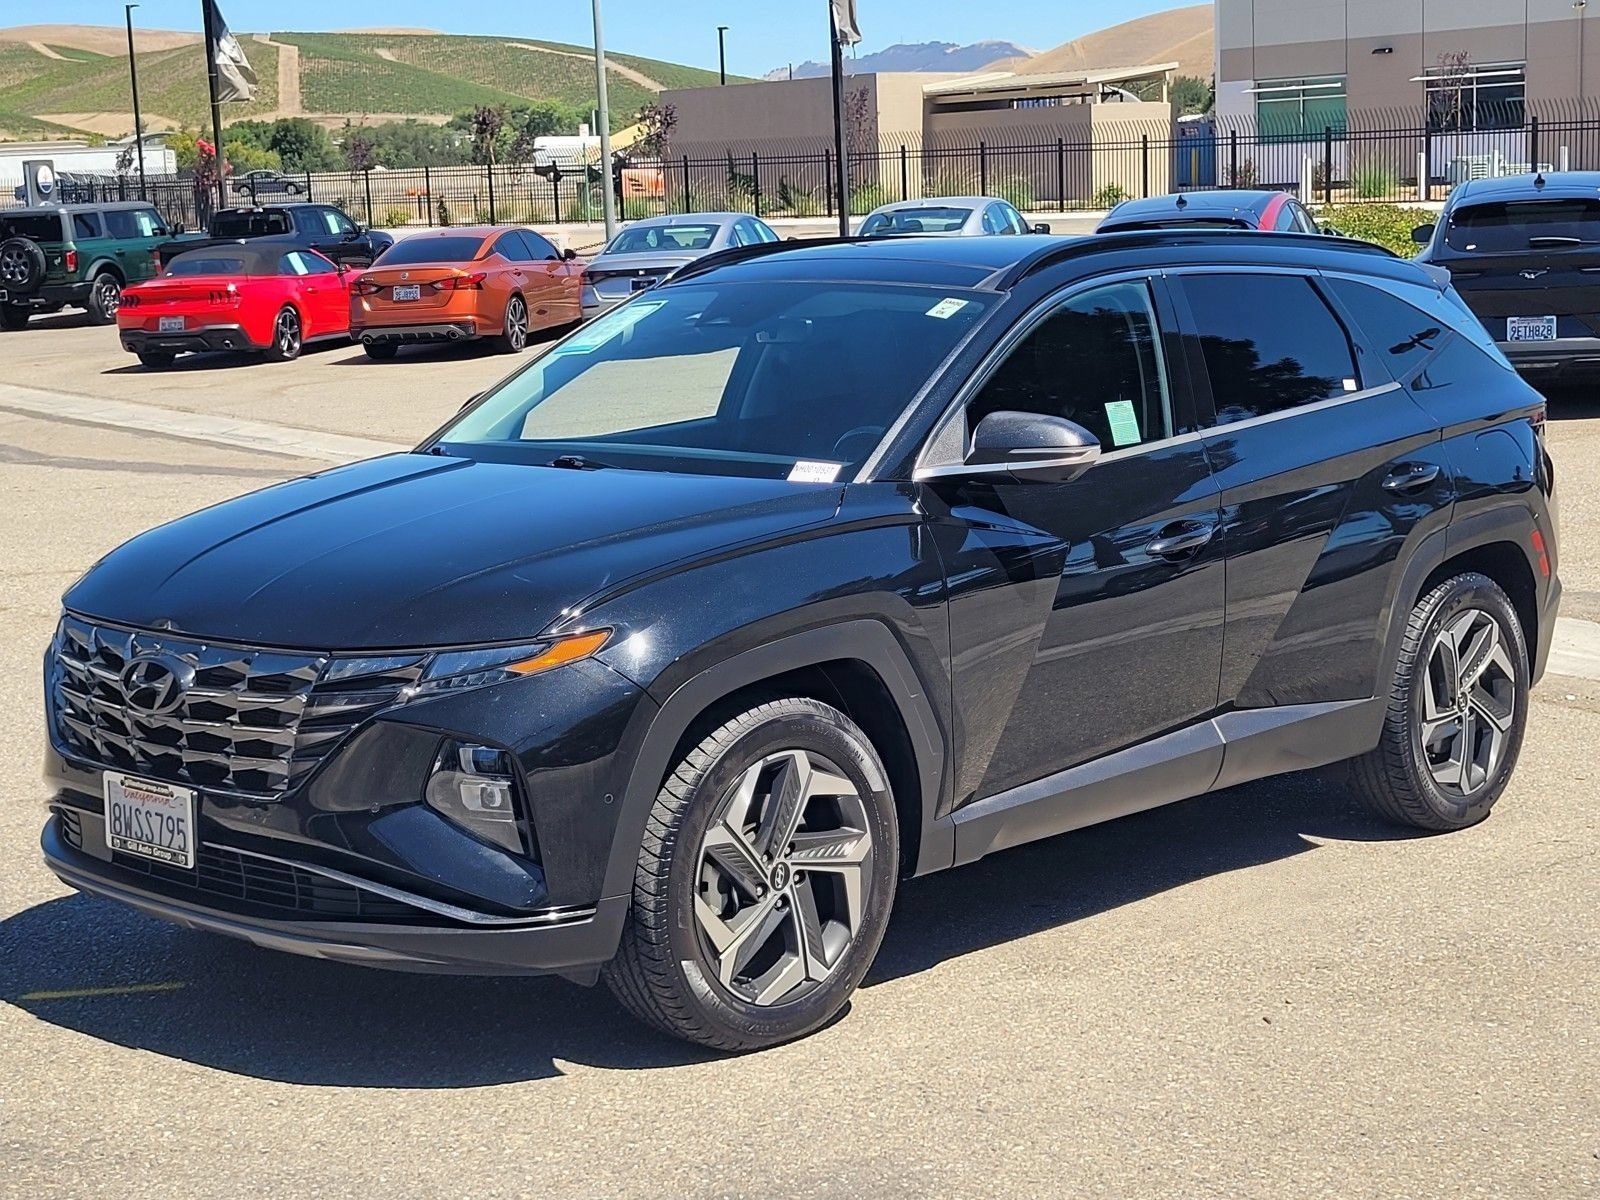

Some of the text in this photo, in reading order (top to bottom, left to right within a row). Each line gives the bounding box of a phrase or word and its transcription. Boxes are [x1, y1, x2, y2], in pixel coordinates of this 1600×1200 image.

[1510, 325, 1553, 340] 9ETH828
[112, 802, 187, 851] 8WSS795
[138, 843, 152, 855] Auto
[153, 847, 172, 860] Group
